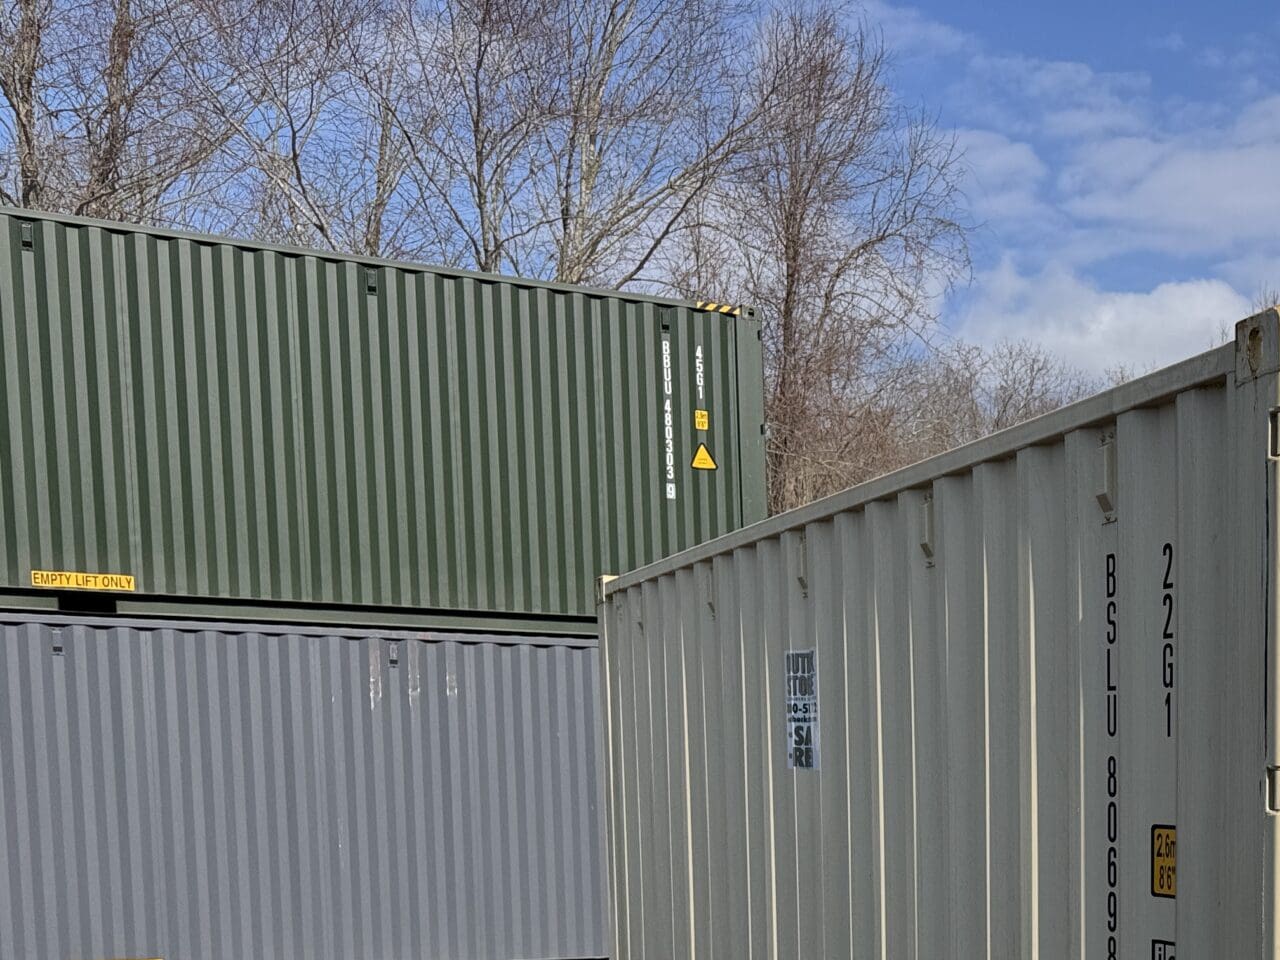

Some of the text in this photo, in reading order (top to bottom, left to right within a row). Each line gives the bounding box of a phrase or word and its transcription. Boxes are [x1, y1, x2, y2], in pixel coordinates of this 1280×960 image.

[662, 340, 672, 395] BBUU
[696, 345, 704, 400] 45G1
[664, 399, 675, 479] 480303
[33, 572, 133, 589] EMPTY LIFT ONLY
[1106, 553, 1117, 737] BSLU
[1162, 543, 1174, 738] 22G1
